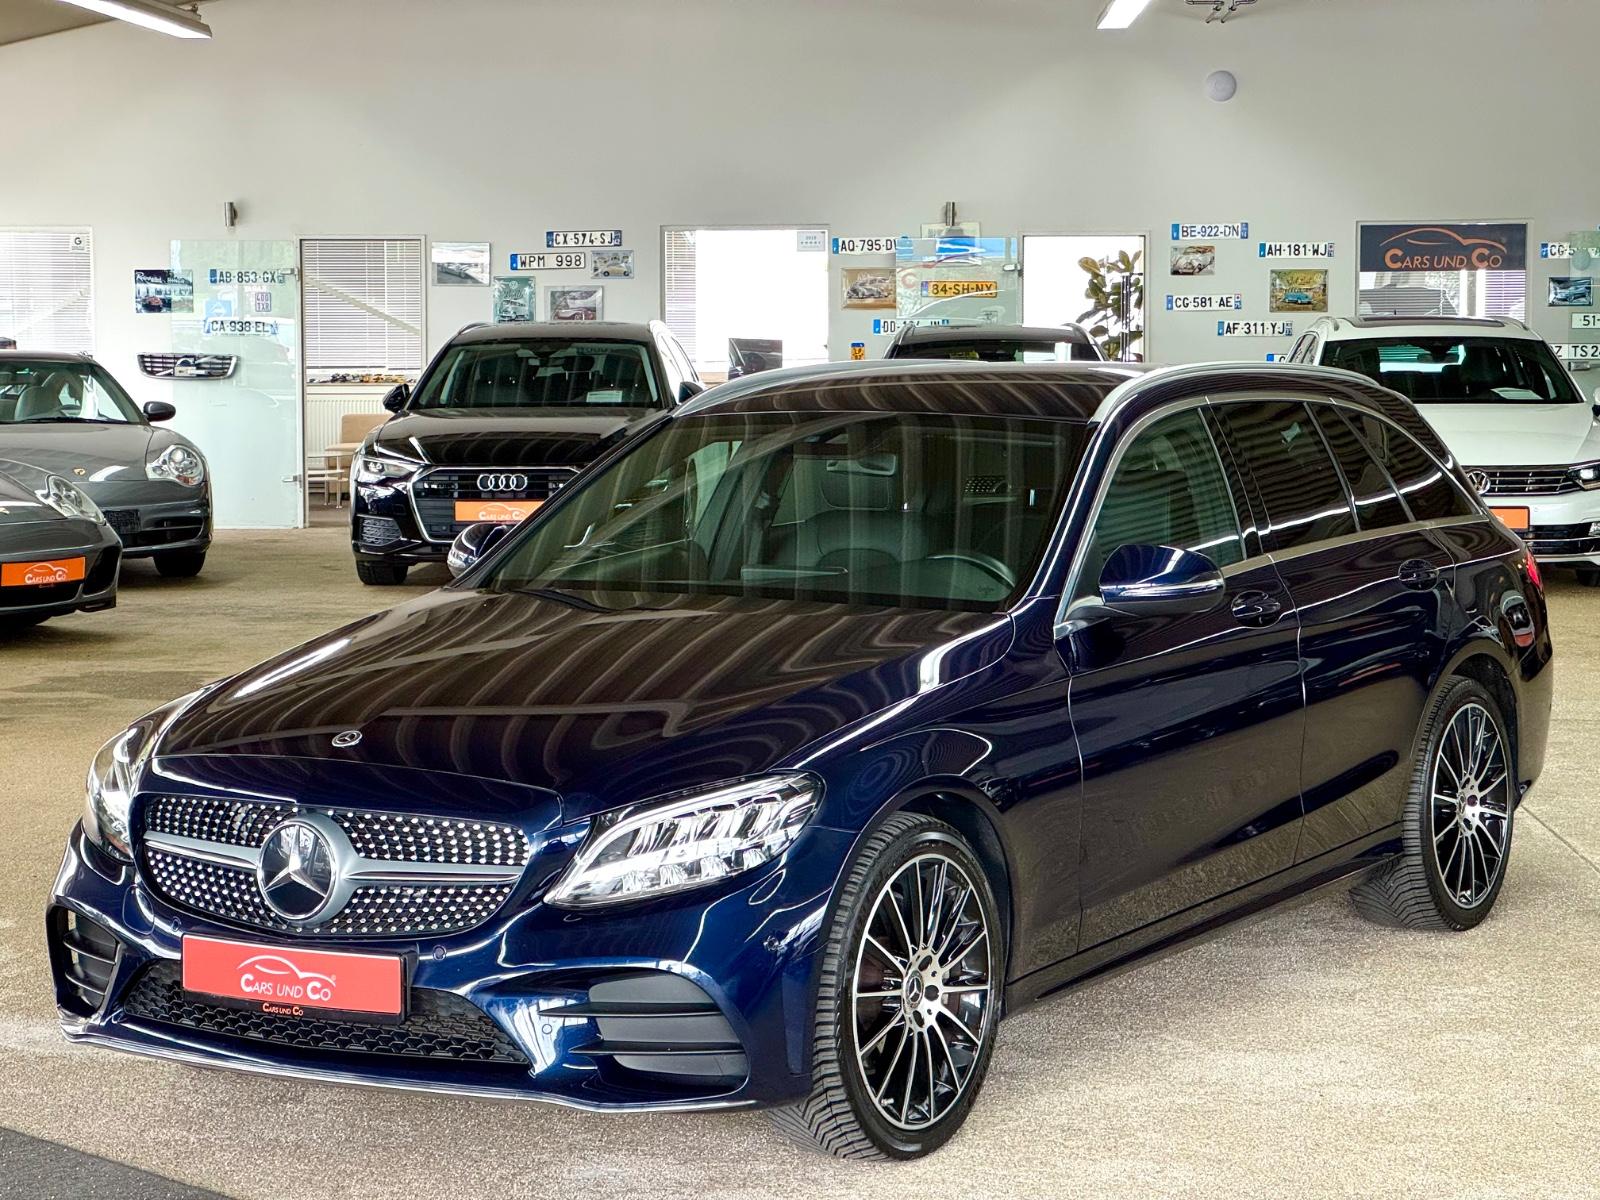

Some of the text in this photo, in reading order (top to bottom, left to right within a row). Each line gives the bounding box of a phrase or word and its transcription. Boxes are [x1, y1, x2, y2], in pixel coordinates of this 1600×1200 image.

[554, 232, 613, 245] CX-574-SJ
[1181, 225, 1239, 238] BE-922-DN
[74, 236, 82, 245] G
[1267, 243, 1327, 257] AH-181-WJ
[519, 254, 582, 268] WPM 998
[1384, 247, 1502, 269] CARS UND CO
[218, 270, 277, 284] AB-853-GX
[210, 320, 270, 334] CA-938-EL
[1225, 321, 1285, 335] AF-311-YJ
[1571, 345, 1588, 357] TS
[240, 973, 331, 1001] CARS UND CO
